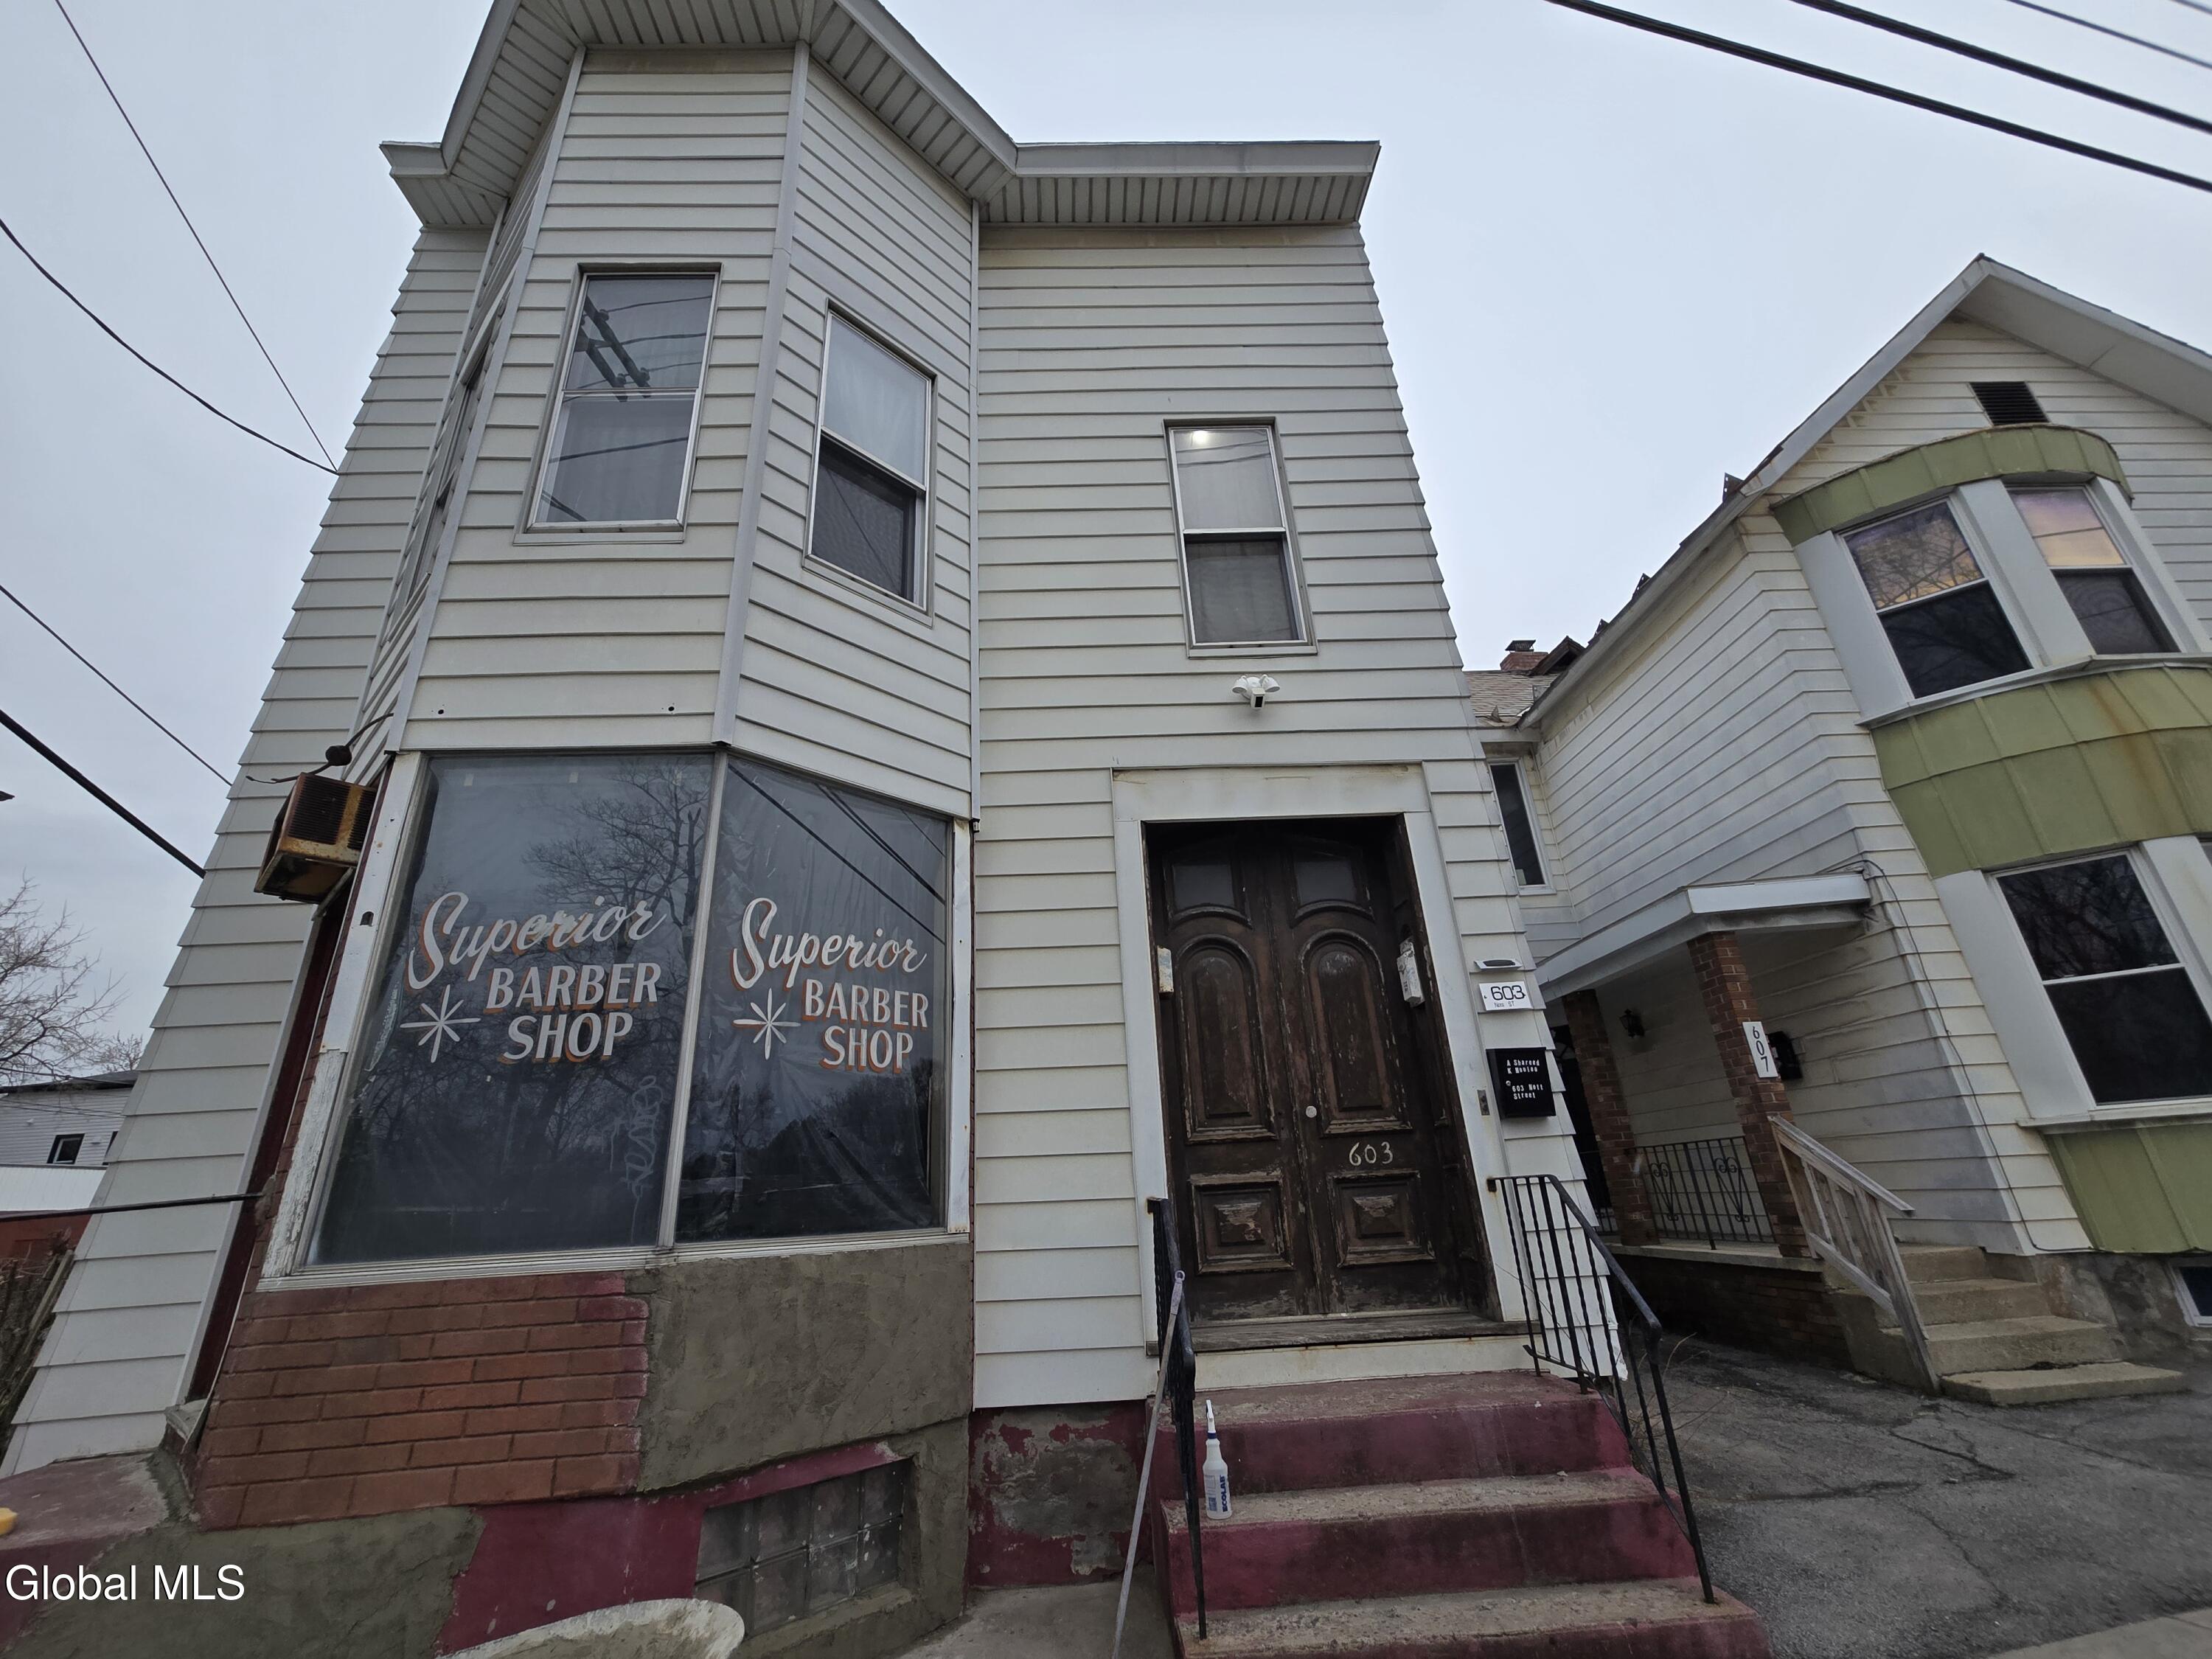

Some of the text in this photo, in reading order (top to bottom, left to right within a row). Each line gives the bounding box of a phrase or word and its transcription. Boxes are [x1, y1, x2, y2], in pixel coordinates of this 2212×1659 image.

[406, 891, 667, 992] Superior
[731, 897, 928, 991] Superior
[484, 962, 661, 1013] BARBER
[801, 978, 929, 1029] BARBER
[1490, 985, 1525, 1001] 603
[498, 1011, 634, 1065] SHOP
[819, 1025, 914, 1074] SHOP
[1752, 1026, 1769, 1073] 607
[1513, 1092, 1536, 1100] Street
[1349, 1141, 1394, 1166] 603
[1220, 1475, 1228, 1512] ECOLAB
